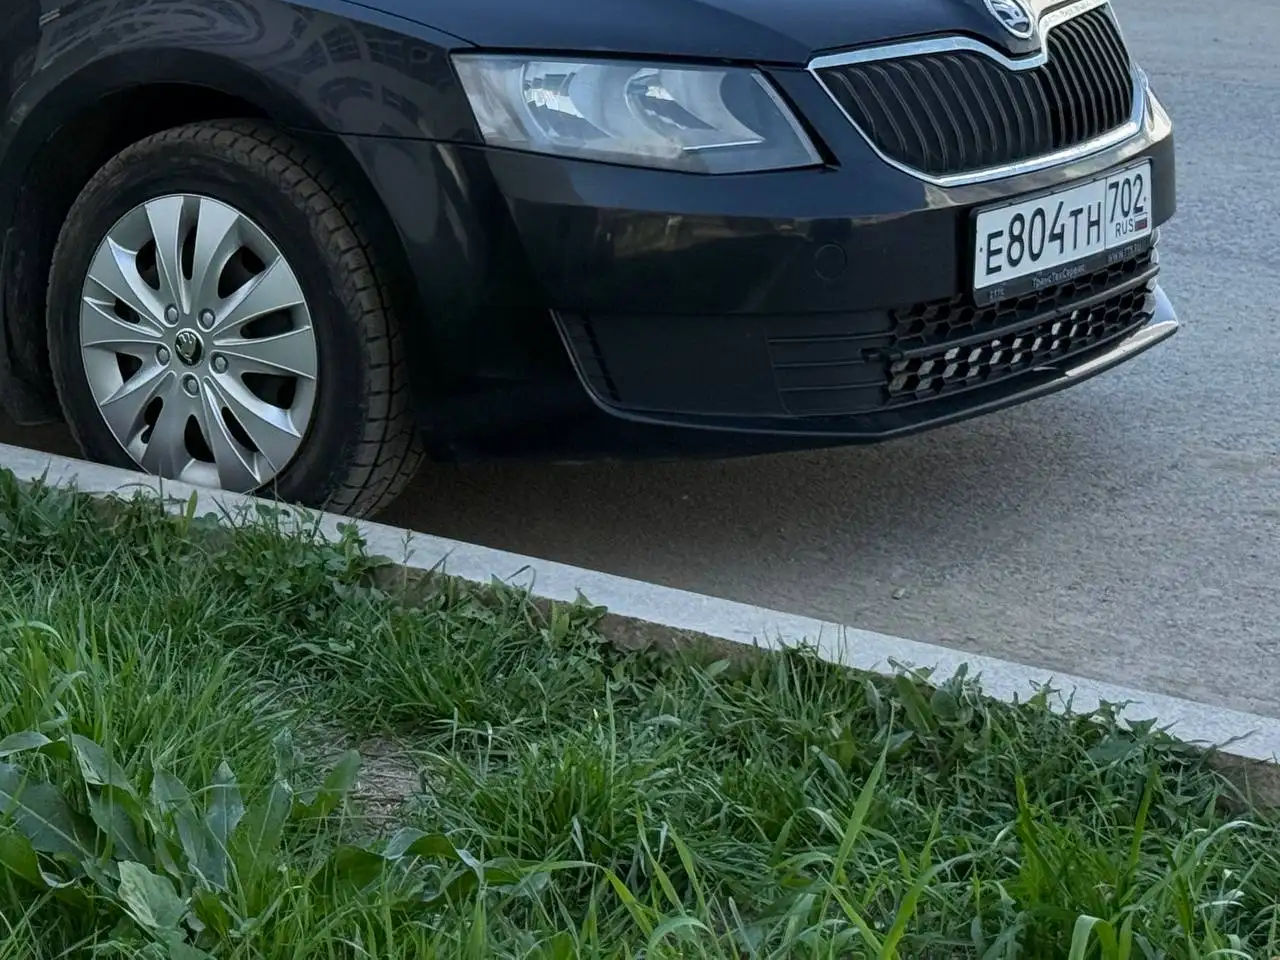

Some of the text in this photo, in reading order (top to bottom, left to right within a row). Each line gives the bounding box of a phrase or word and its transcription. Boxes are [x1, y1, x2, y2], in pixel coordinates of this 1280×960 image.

[985, 173, 1144, 276] Е804ТН 702
[1115, 218, 1134, 238] RUS
